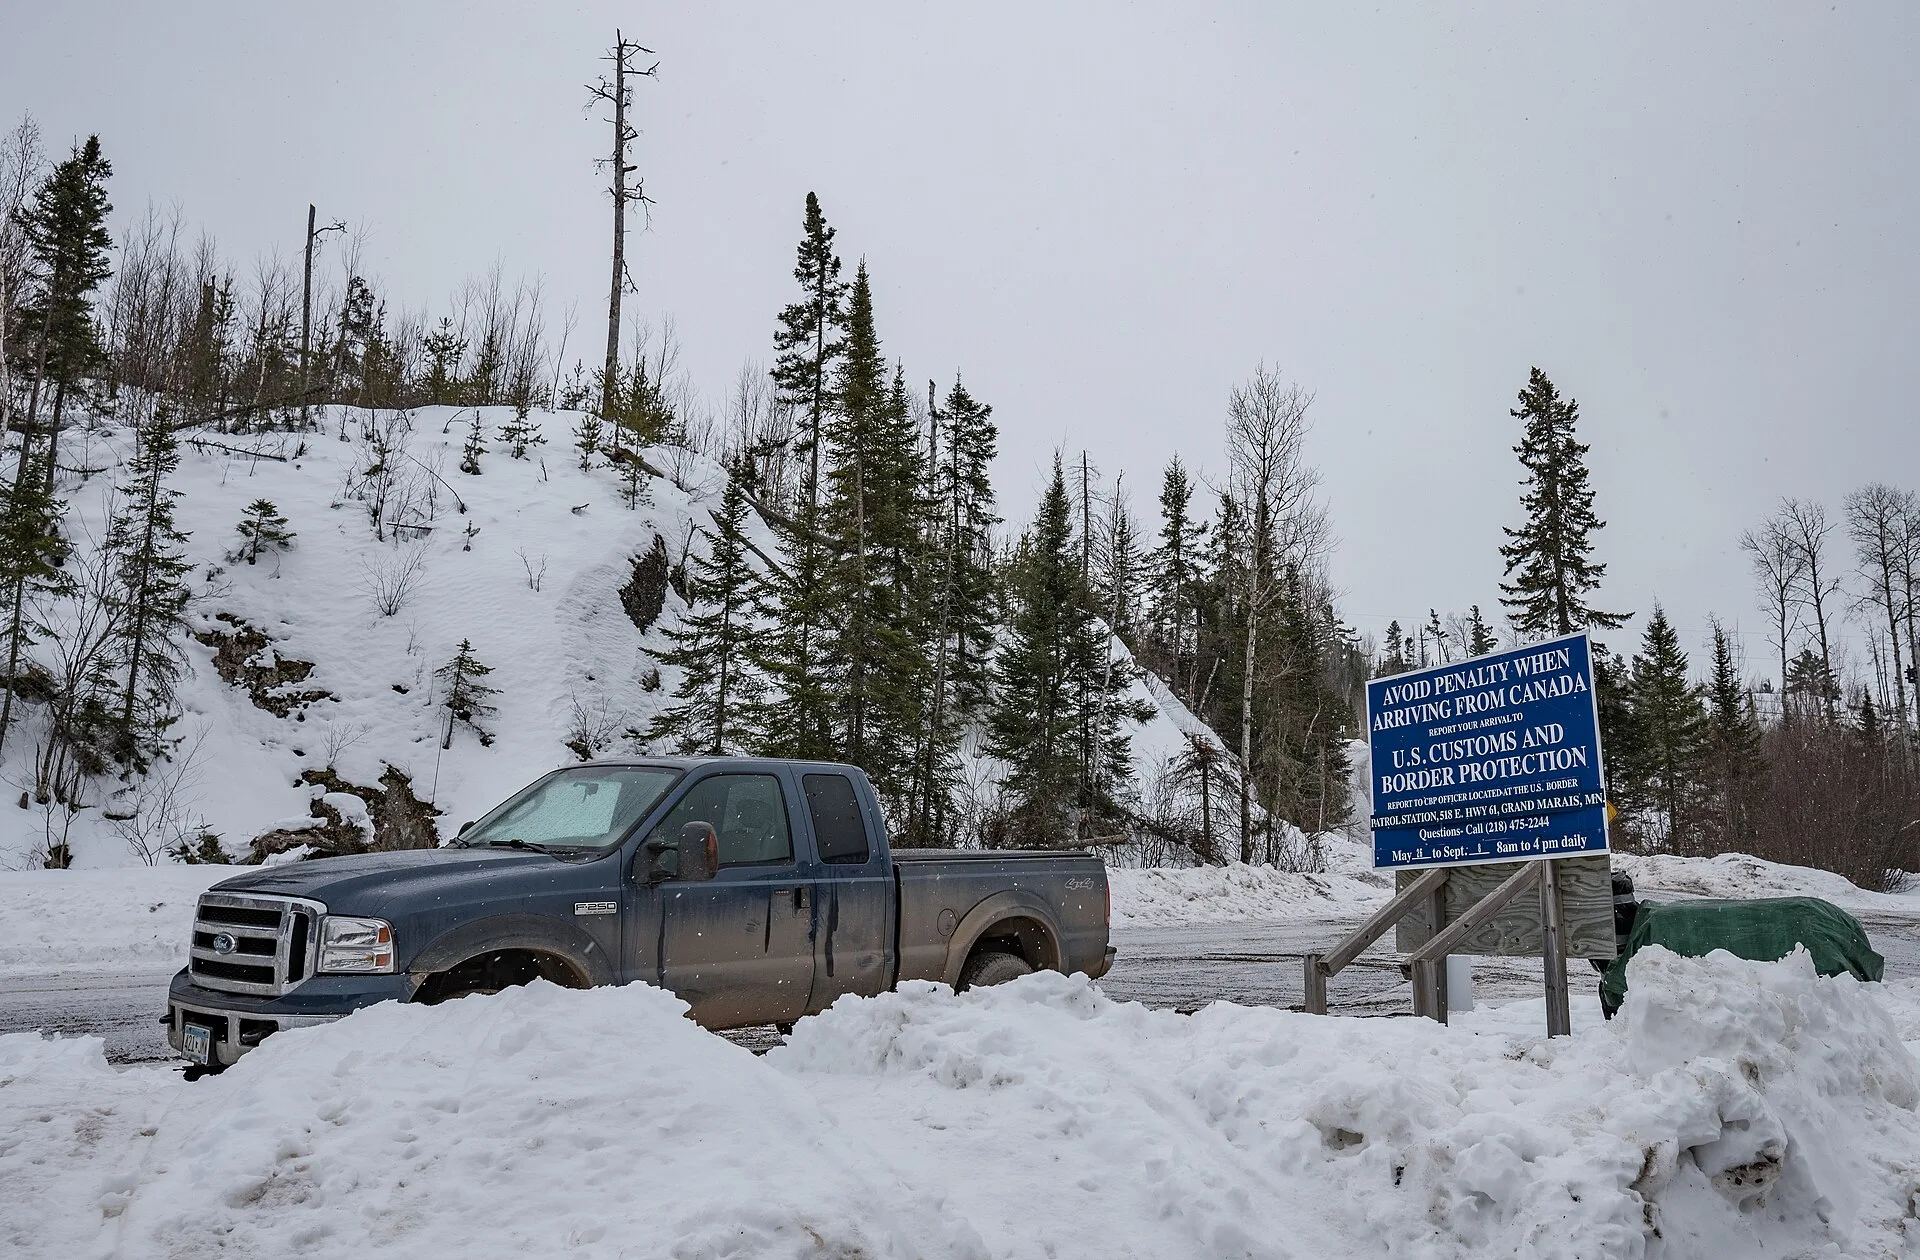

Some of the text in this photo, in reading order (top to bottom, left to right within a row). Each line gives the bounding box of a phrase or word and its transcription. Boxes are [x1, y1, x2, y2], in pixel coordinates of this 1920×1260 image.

[1383, 648, 1570, 706] AVOID PENALTY WHEN
[1373, 672, 1587, 731] ARRIVING FROM CANADA
[1428, 712, 1523, 737] REPORT YOUR ARRIVAL TO
[1392, 723, 1564, 769] U.S. CUSTOMS AND
[1381, 745, 1587, 794] BORDER PROTECTION
[1387, 778, 1578, 810] REPORT TO CBP OFFICER LOCATED AT THE U.S. BORDER
[1371, 816, 1400, 828] PATROL
[1401, 811, 1439, 824] STATION,
[1439, 809, 1453, 821] 518
[1454, 808, 1464, 819] E.
[1465, 805, 1488, 818] HWY
[1489, 804, 1500, 816] 61,
[1501, 800, 1535, 814] GRAND
[1537, 795, 1583, 810] MARAIS,
[1419, 815, 1550, 841] Questions- Call (218) 475-2244
[1392, 849, 1412, 863] May
[1432, 848, 1442, 859] to
[1496, 841, 1518, 854] 8am
[1520, 840, 1531, 851] to
[1533, 836, 1540, 850] 4
[1542, 839, 1559, 853] pm
[1561, 833, 1587, 849] daily
